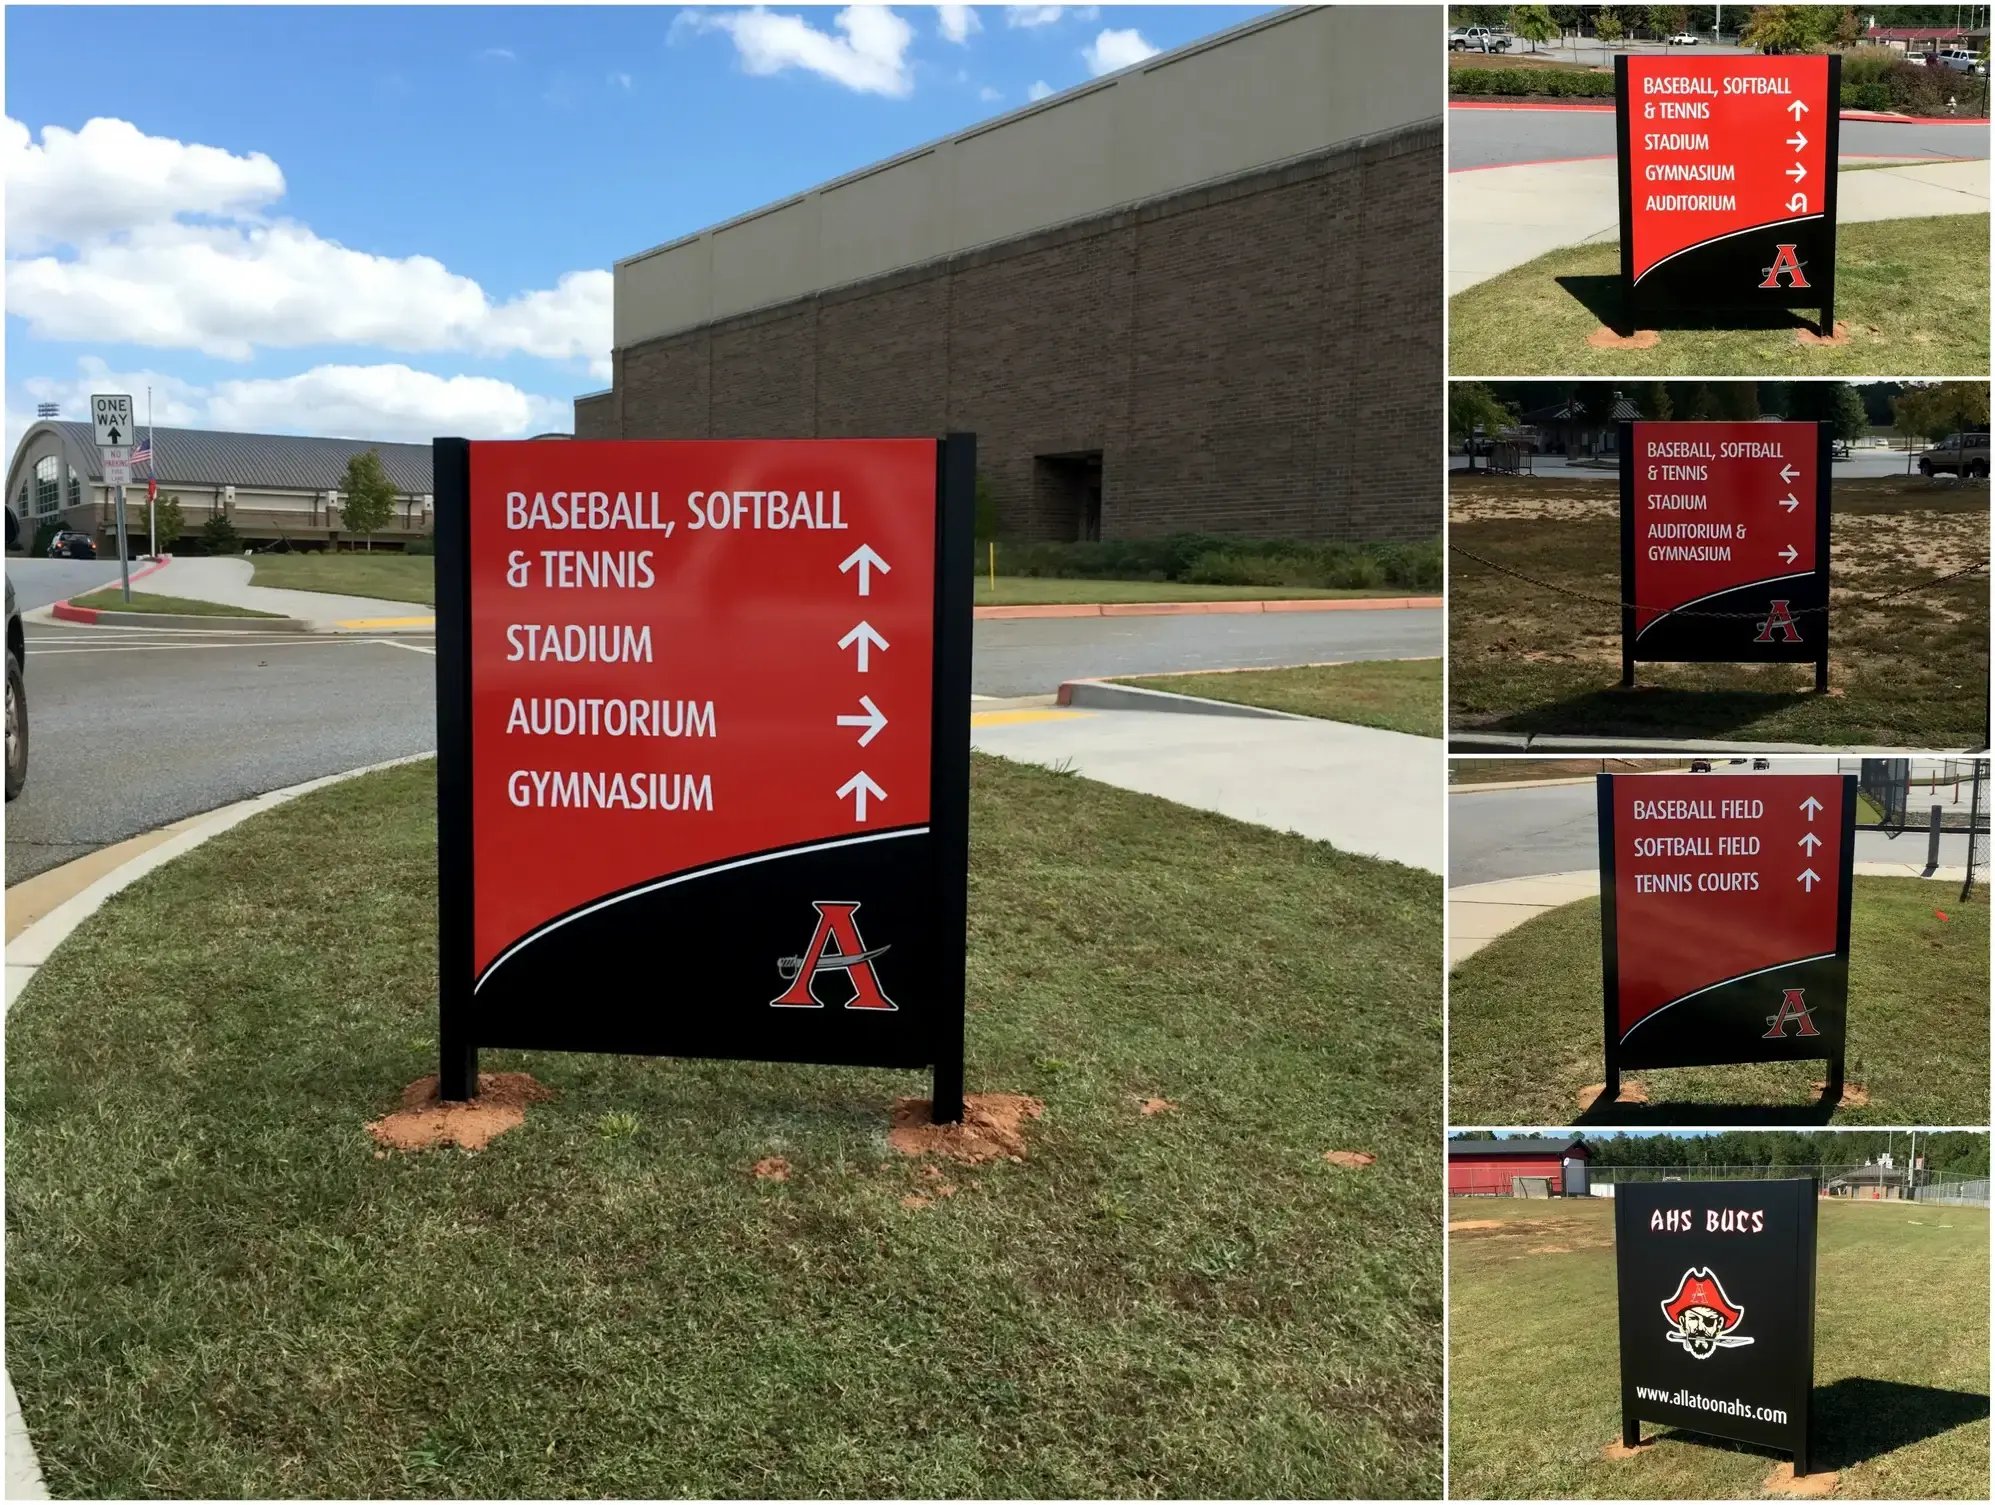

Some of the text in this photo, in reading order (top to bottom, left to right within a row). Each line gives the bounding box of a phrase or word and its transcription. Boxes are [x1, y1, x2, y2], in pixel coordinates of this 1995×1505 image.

[1643, 77, 1792, 98] BASEBALL, SOFTBALL
[1644, 102, 1710, 119] & TENNIS
[1644, 134, 1709, 151] STADIUM
[1645, 164, 1735, 181] GYMNASIUM
[1645, 195, 1736, 211] AUDITORIUM
[1758, 244, 1811, 288] A
[97, 399, 127, 412] ONE
[96, 413, 128, 426] WAY
[110, 450, 122, 458] NO
[1647, 442, 1784, 461] BASEBALL, SOFTBALL
[1647, 465, 1708, 481] & TENNIS
[1647, 494, 1707, 510] STADIUM
[506, 491, 848, 539] BASEBALL, SOFTBALL
[1647, 524, 1747, 540] AUDITORIUM &
[1648, 546, 1731, 561] GYMNASIUM
[506, 550, 656, 589] & TENNIS
[1753, 600, 1804, 643] A
[506, 624, 653, 663] STADIUM
[506, 698, 717, 738] AUDITORIUM
[507, 770, 714, 812] GYMNASIUM
[1633, 800, 1764, 820] BASEBALL FIELD
[1634, 836, 1761, 857] SOFTBALL FIELD
[1634, 872, 1759, 893] TENNIS COURTS
[769, 900, 899, 1012] A
[1762, 988, 1821, 1039] A
[1650, 1207, 1764, 1233] AHS BUCS
[1636, 1386, 1788, 1425] www.allatoonahs.com
